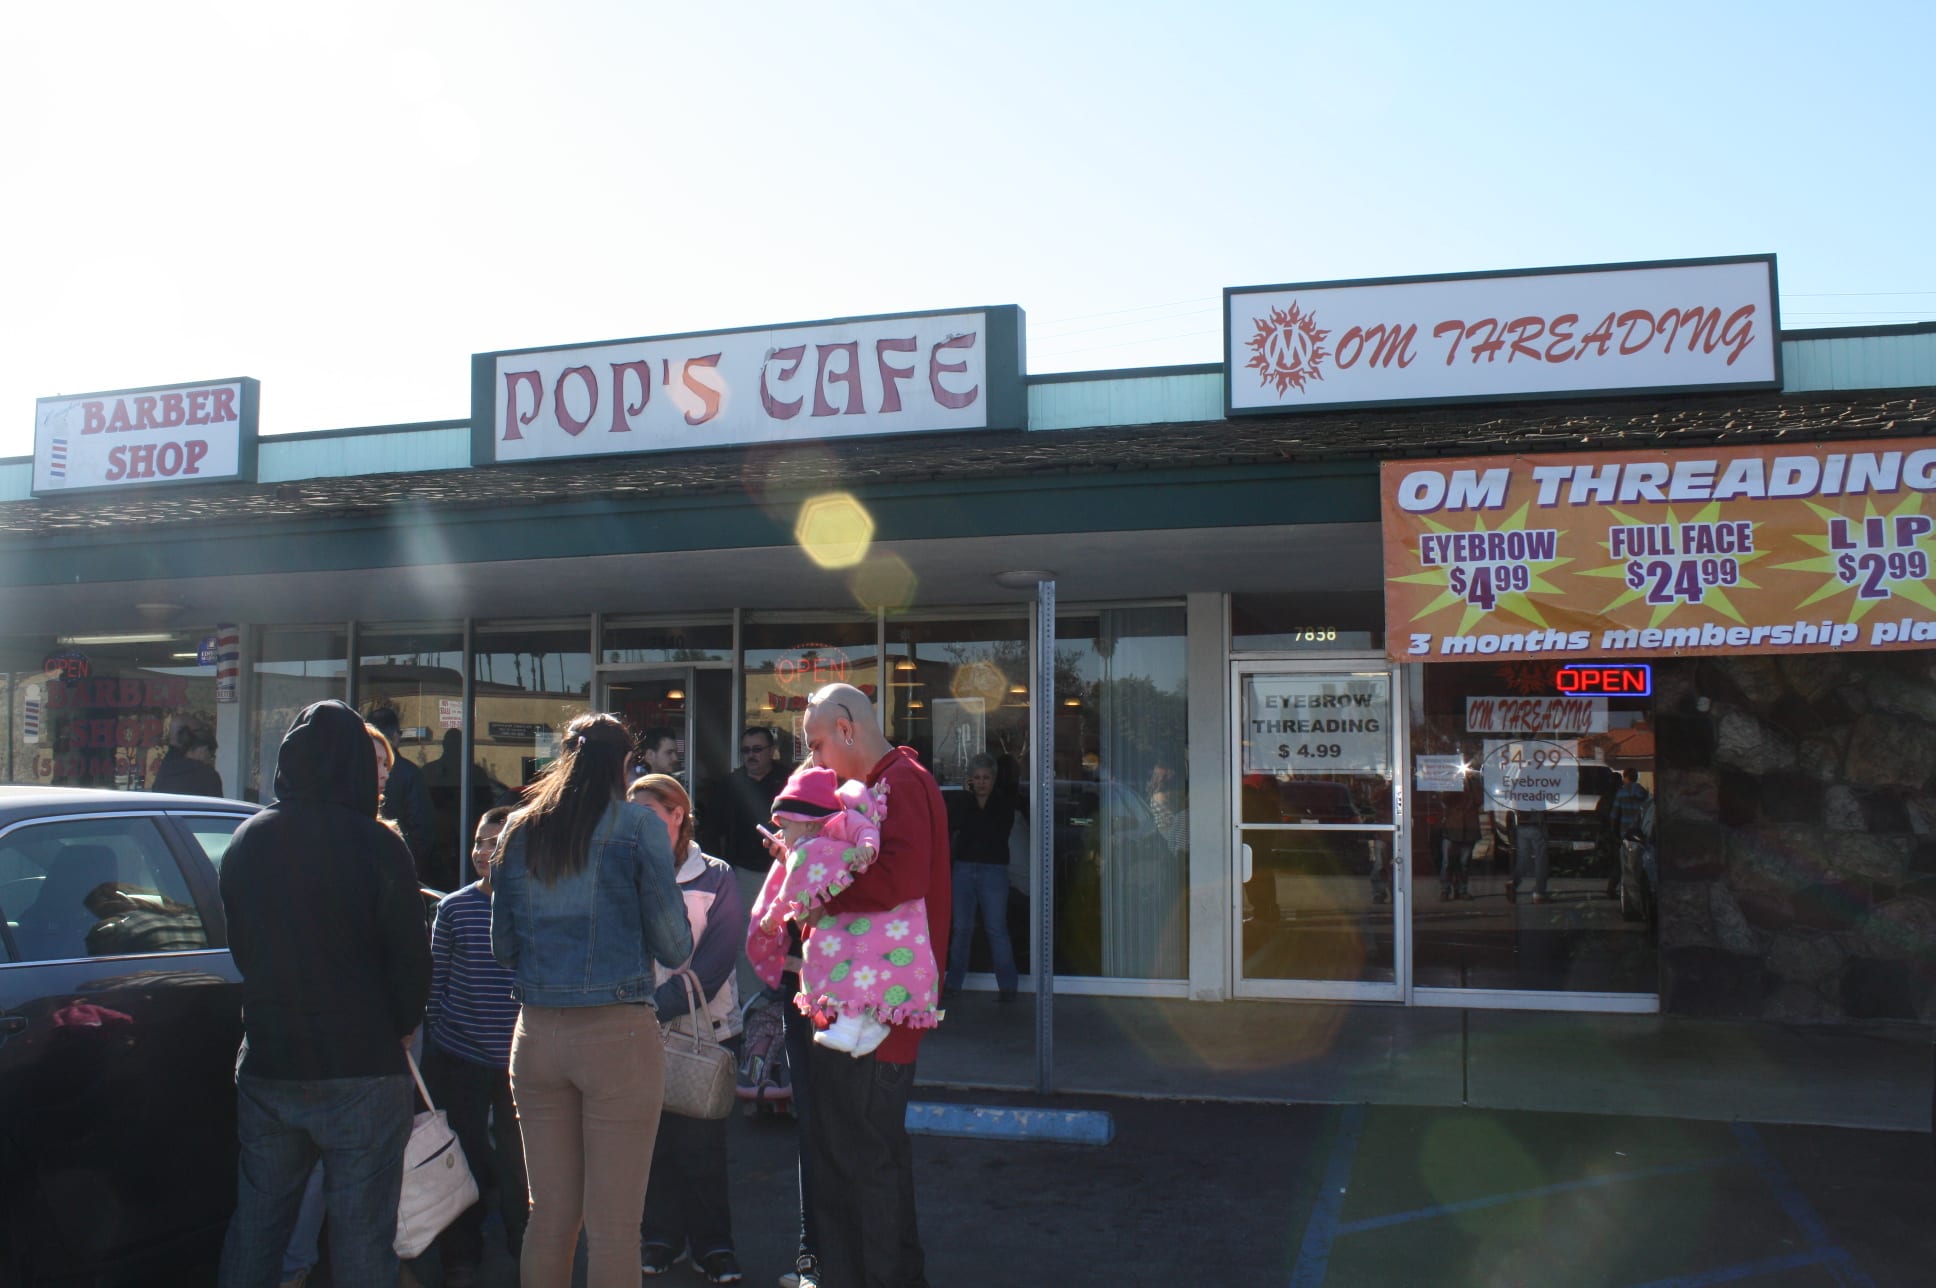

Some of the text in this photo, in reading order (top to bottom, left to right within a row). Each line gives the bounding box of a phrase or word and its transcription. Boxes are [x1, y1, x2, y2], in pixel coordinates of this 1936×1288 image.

[1333, 304, 1757, 370] OM THREADING
[503, 331, 980, 441] POP'S CAFE
[80, 387, 238, 435] BARBER
[105, 440, 208, 480] SHOP
[1398, 450, 1936, 511] OM THREADING
[1419, 529, 1557, 566] EYEBROW
[1610, 521, 1753, 558] FULL FACE
[1407, 633, 1430, 655] 3
[1441, 629, 1590, 654] months
[1602, 621, 1858, 650] membership
[44, 658, 89, 679] OPEN
[776, 657, 845, 683] OPEN
[1557, 670, 1645, 692] OPEN
[46, 678, 189, 708] BARBER
[1265, 694, 1371, 709] EYEBROW
[1252, 719, 1380, 734] THREADING
[1468, 699, 1594, 733] OM THREADING
[70, 719, 162, 748] SHOP
[1278, 744, 1342, 760] $ 4.99
[1500, 749, 1562, 771] $4.99
[1502, 776, 1562, 791] Eyebrow
[1502, 790, 1561, 804] Threading
